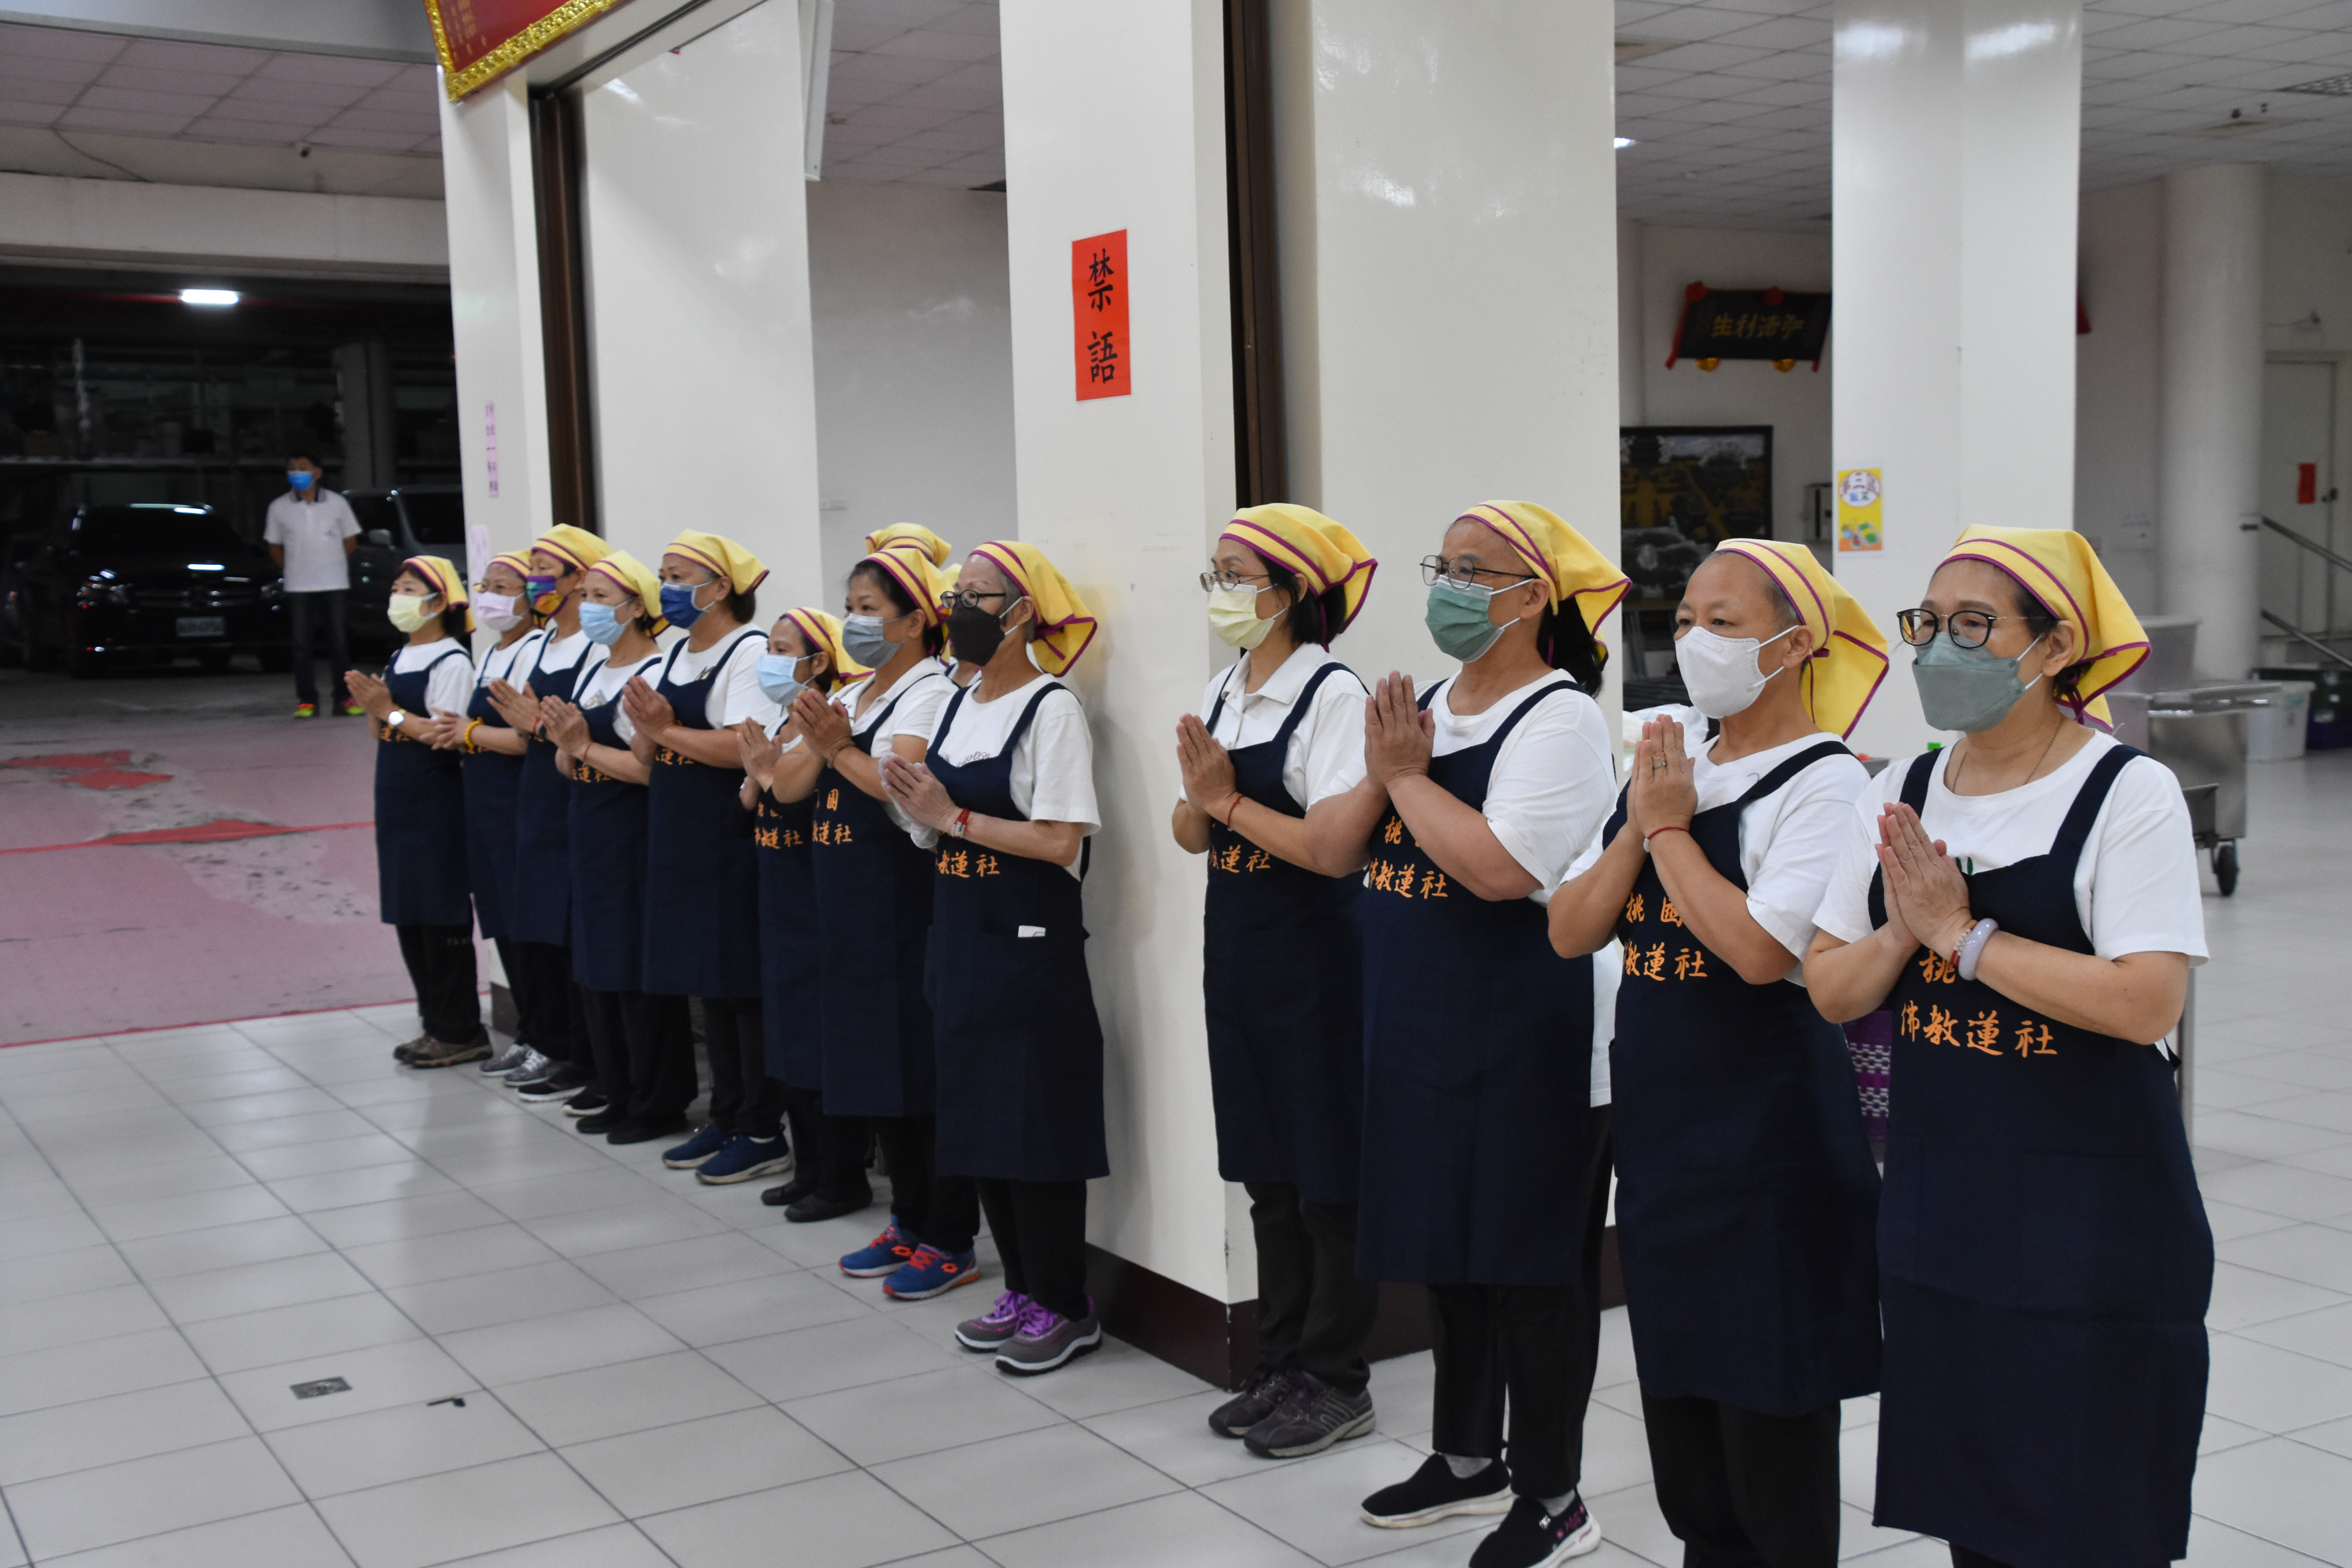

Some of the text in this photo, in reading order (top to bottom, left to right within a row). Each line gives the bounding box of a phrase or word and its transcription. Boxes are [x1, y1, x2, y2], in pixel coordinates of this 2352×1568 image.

[1087, 248, 1118, 384] 禁語
[935, 849, 1001, 878] 教蓮社
[1624, 939, 1708, 981] 教蓮社
[1901, 999, 2058, 1058] 佛教蓮社
